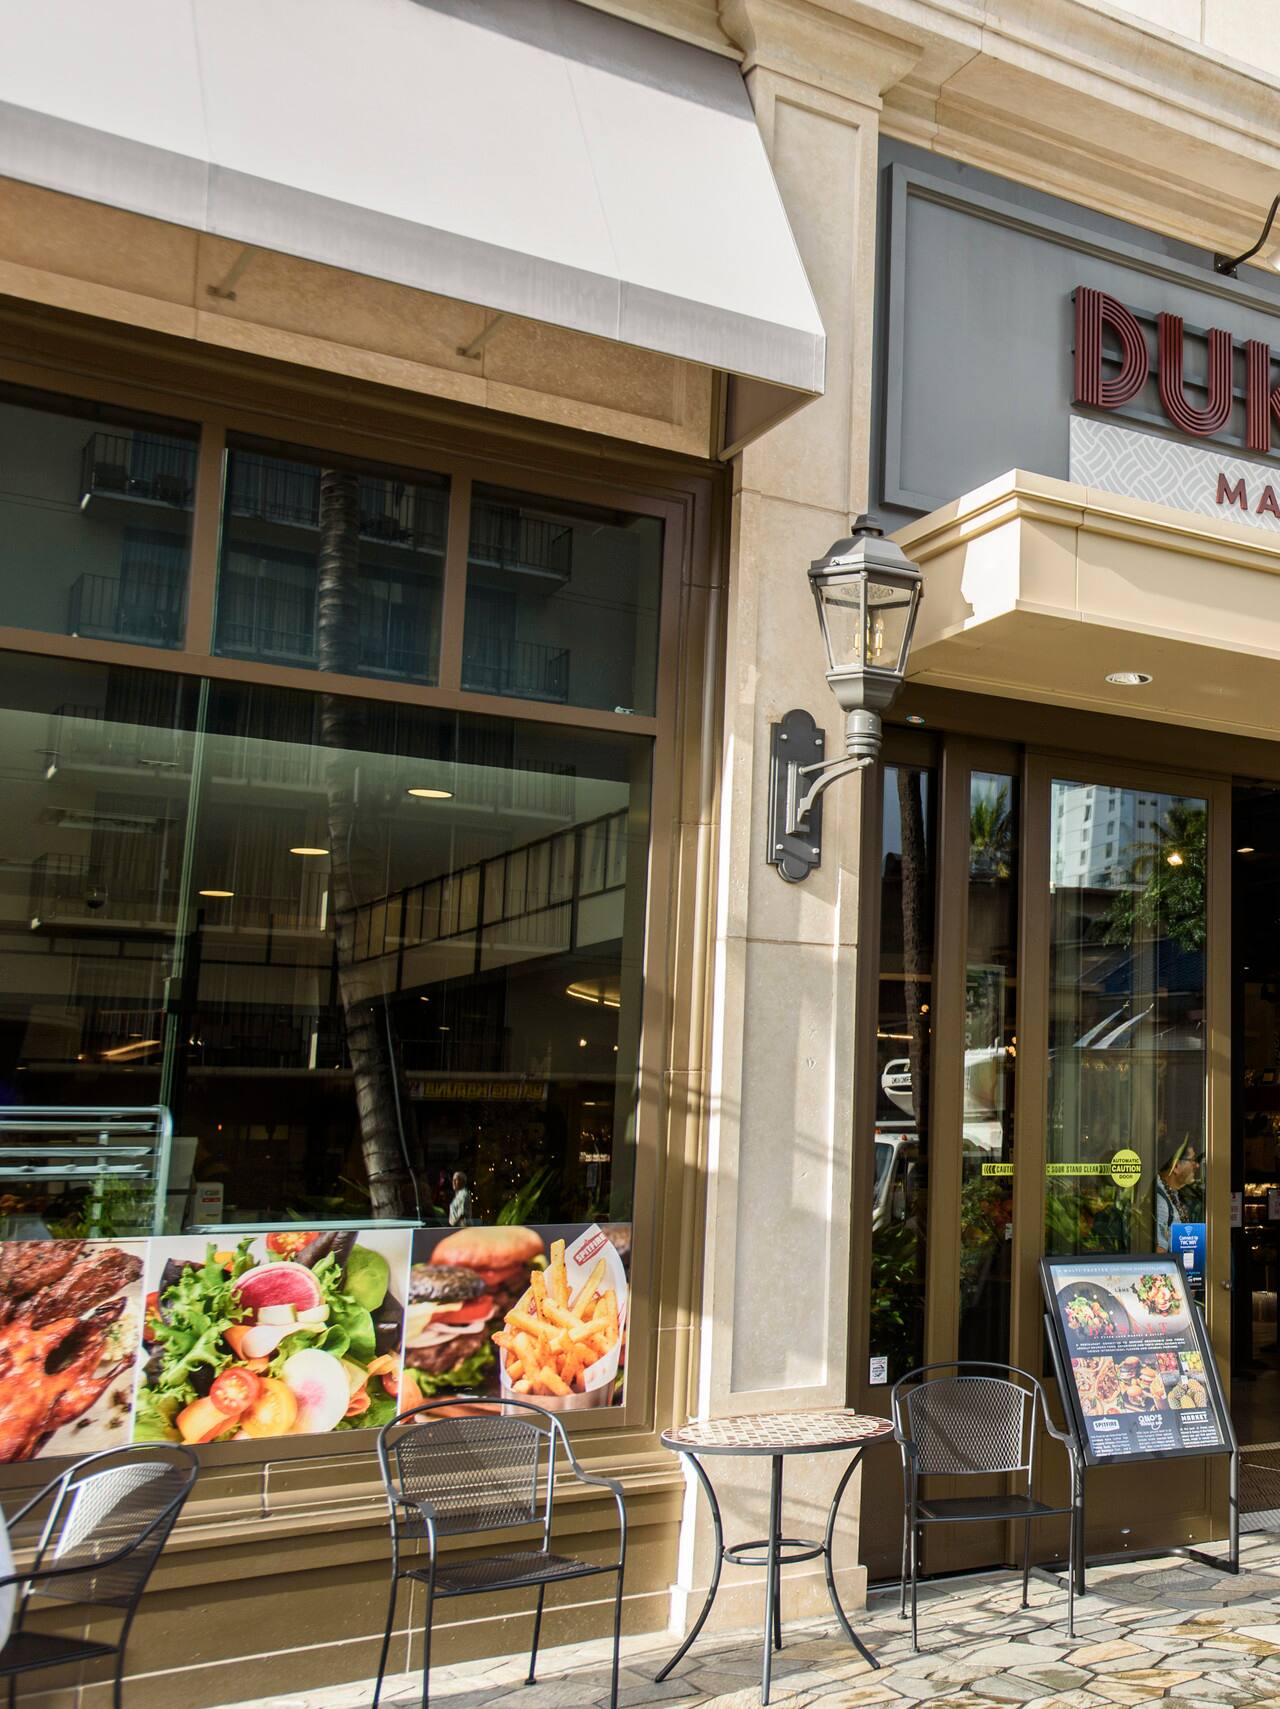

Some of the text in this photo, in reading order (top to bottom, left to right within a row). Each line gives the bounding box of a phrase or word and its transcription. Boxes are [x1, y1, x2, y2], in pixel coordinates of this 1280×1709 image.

[1066, 1165, 1083, 1174] STAND
[1083, 1165, 1099, 1174] CLEAR
[1111, 1165, 1141, 1173] CAUTION
[575, 1232, 607, 1262] SPITFIRE
